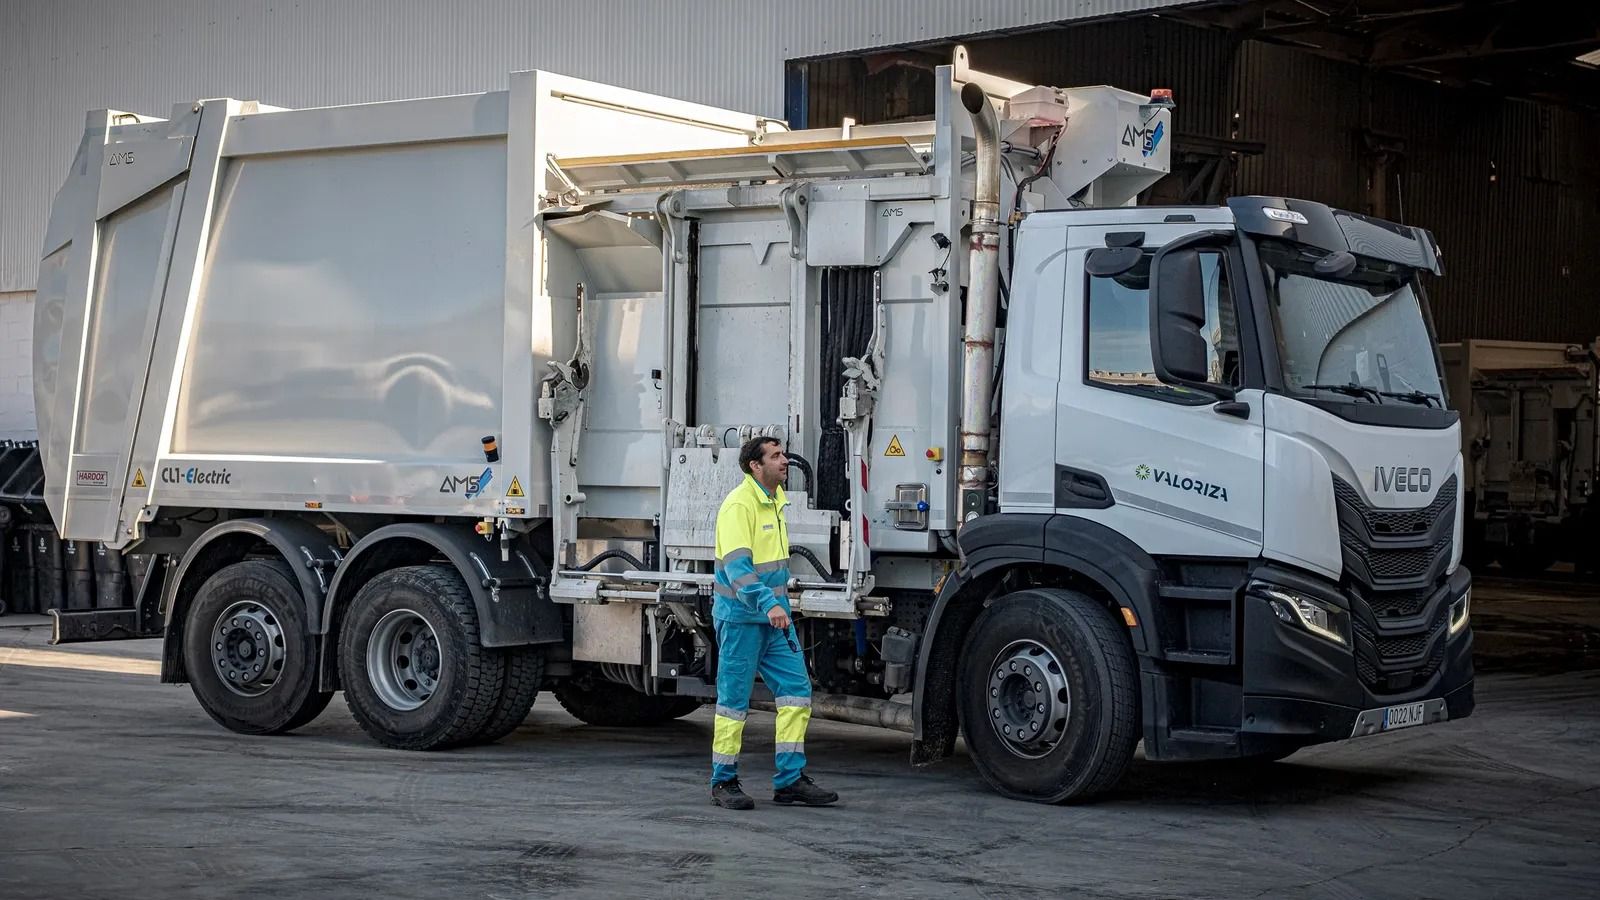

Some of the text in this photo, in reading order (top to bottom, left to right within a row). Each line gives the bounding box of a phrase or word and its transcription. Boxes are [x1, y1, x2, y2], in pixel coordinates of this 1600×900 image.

[1121, 124, 1155, 151] AMS
[109, 151, 134, 166] AMS
[882, 207, 903, 217] AMS
[78, 472, 105, 481] HARDOX
[439, 475, 481, 493] AMS
[1153, 468, 1228, 503] VALORIZA
[1374, 466, 1432, 493] IVECO
[1388, 707, 1408, 726] 0022
